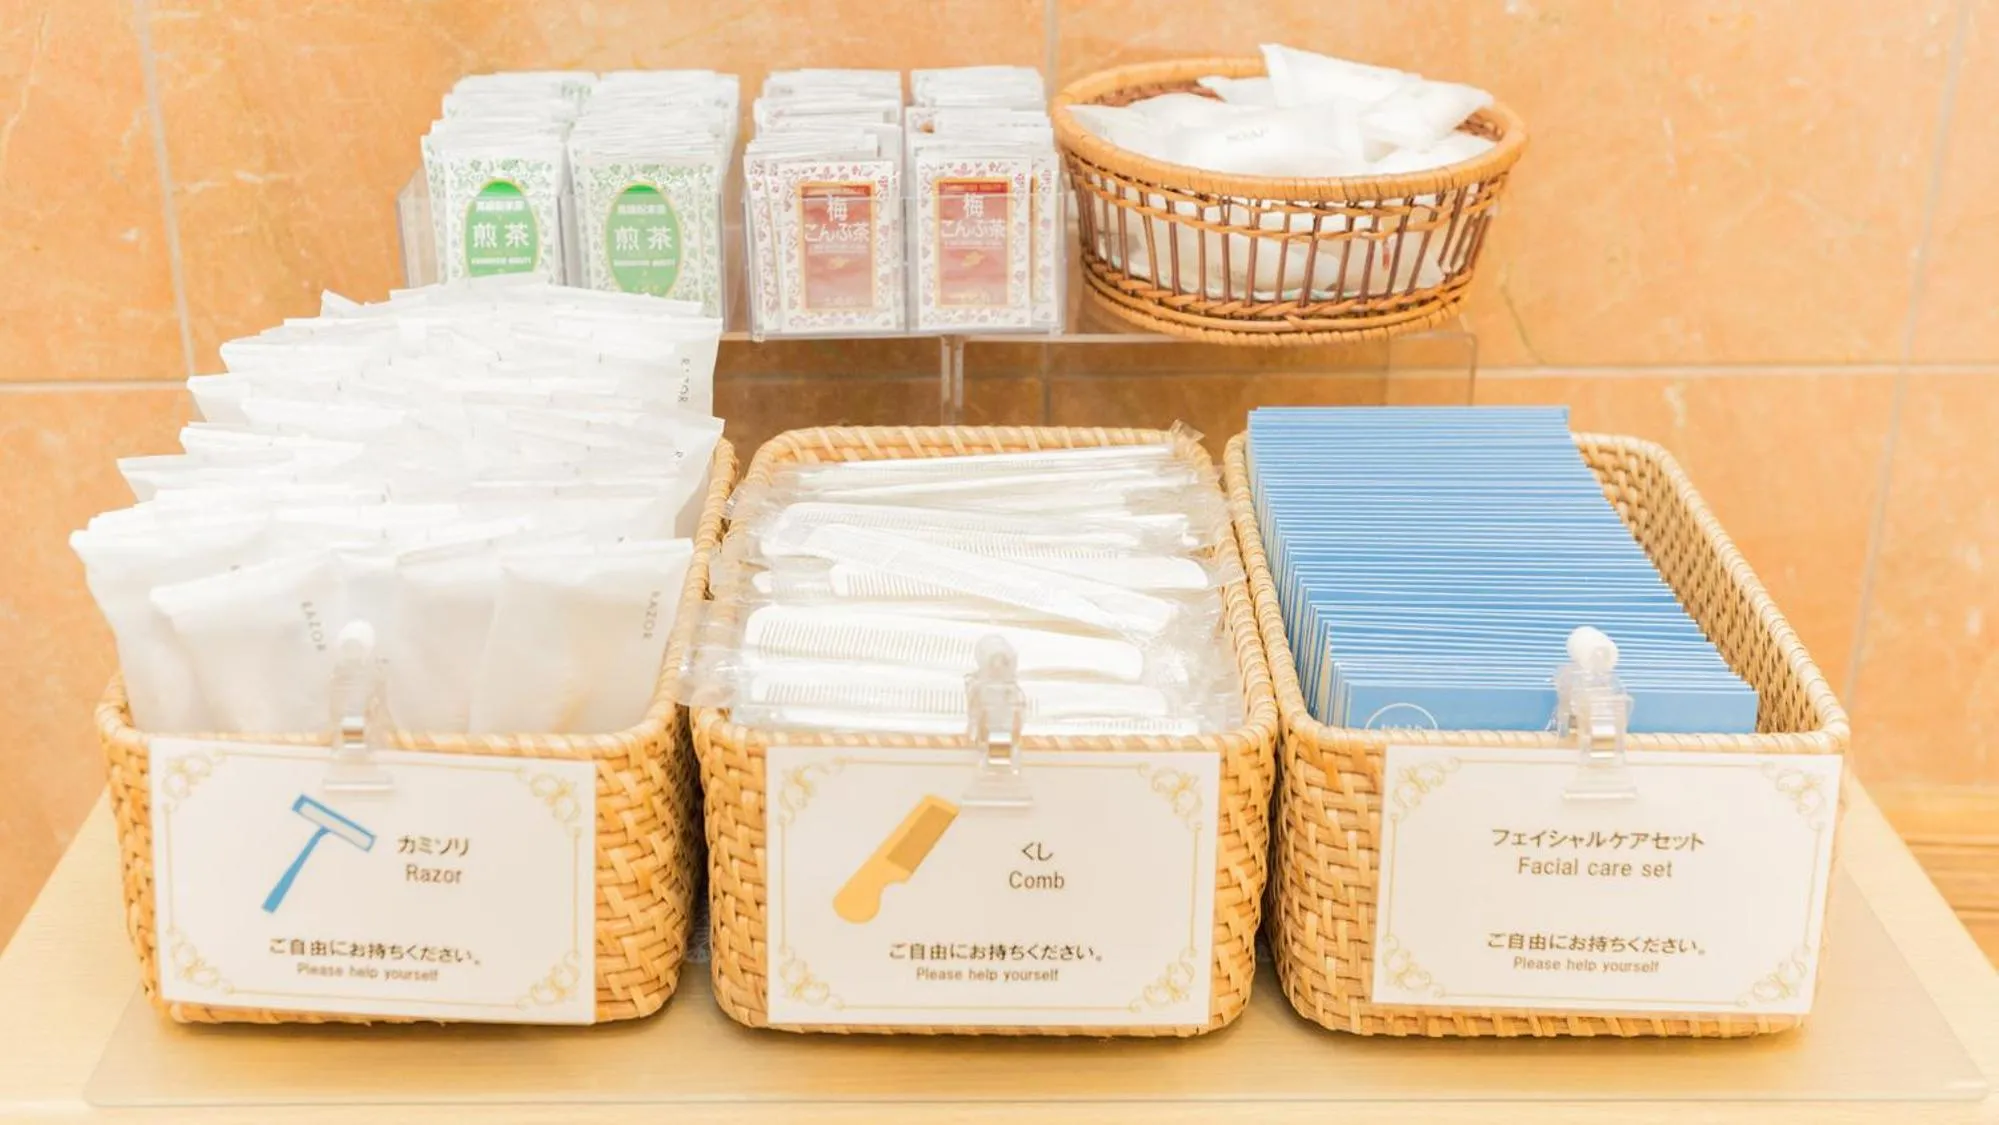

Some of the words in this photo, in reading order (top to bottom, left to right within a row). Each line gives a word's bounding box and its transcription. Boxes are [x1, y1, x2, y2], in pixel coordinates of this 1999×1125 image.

[827, 193, 848, 222] 梅
[963, 191, 984, 219] 梅
[472, 222, 530, 248] 煎茶
[613, 225, 673, 251] 煎茶
[804, 222, 871, 242] こんぶ茶
[941, 218, 1006, 239] こんぶ茶
[301, 601, 327, 651] RAZOR
[642, 590, 661, 640] RAZOR
[398, 835, 469, 857] カミソリ
[1491, 828, 1705, 852] フェイシャルケアセット
[1021, 841, 1054, 862] くし
[405, 863, 462, 884] Razor
[1517, 856, 1578, 876] Facial
[1587, 862, 1633, 877] care
[1641, 860, 1673, 878] set
[1008, 870, 1065, 889] Comb
[269, 938, 481, 965] ご自由にお持ちください。
[889, 942, 1103, 963] ご自由にお持ちください。
[1487, 932, 1706, 956] ご自由にお持ちください。
[296, 961, 344, 977] Please
[349, 965, 379, 979] help
[384, 969, 439, 982] yourself
[915, 967, 963, 981] Please
[968, 968, 999, 982] help
[1003, 968, 1059, 982] yourself
[1513, 955, 1562, 970] Please
[1566, 957, 1598, 972] help
[1602, 958, 1660, 974] yourself
